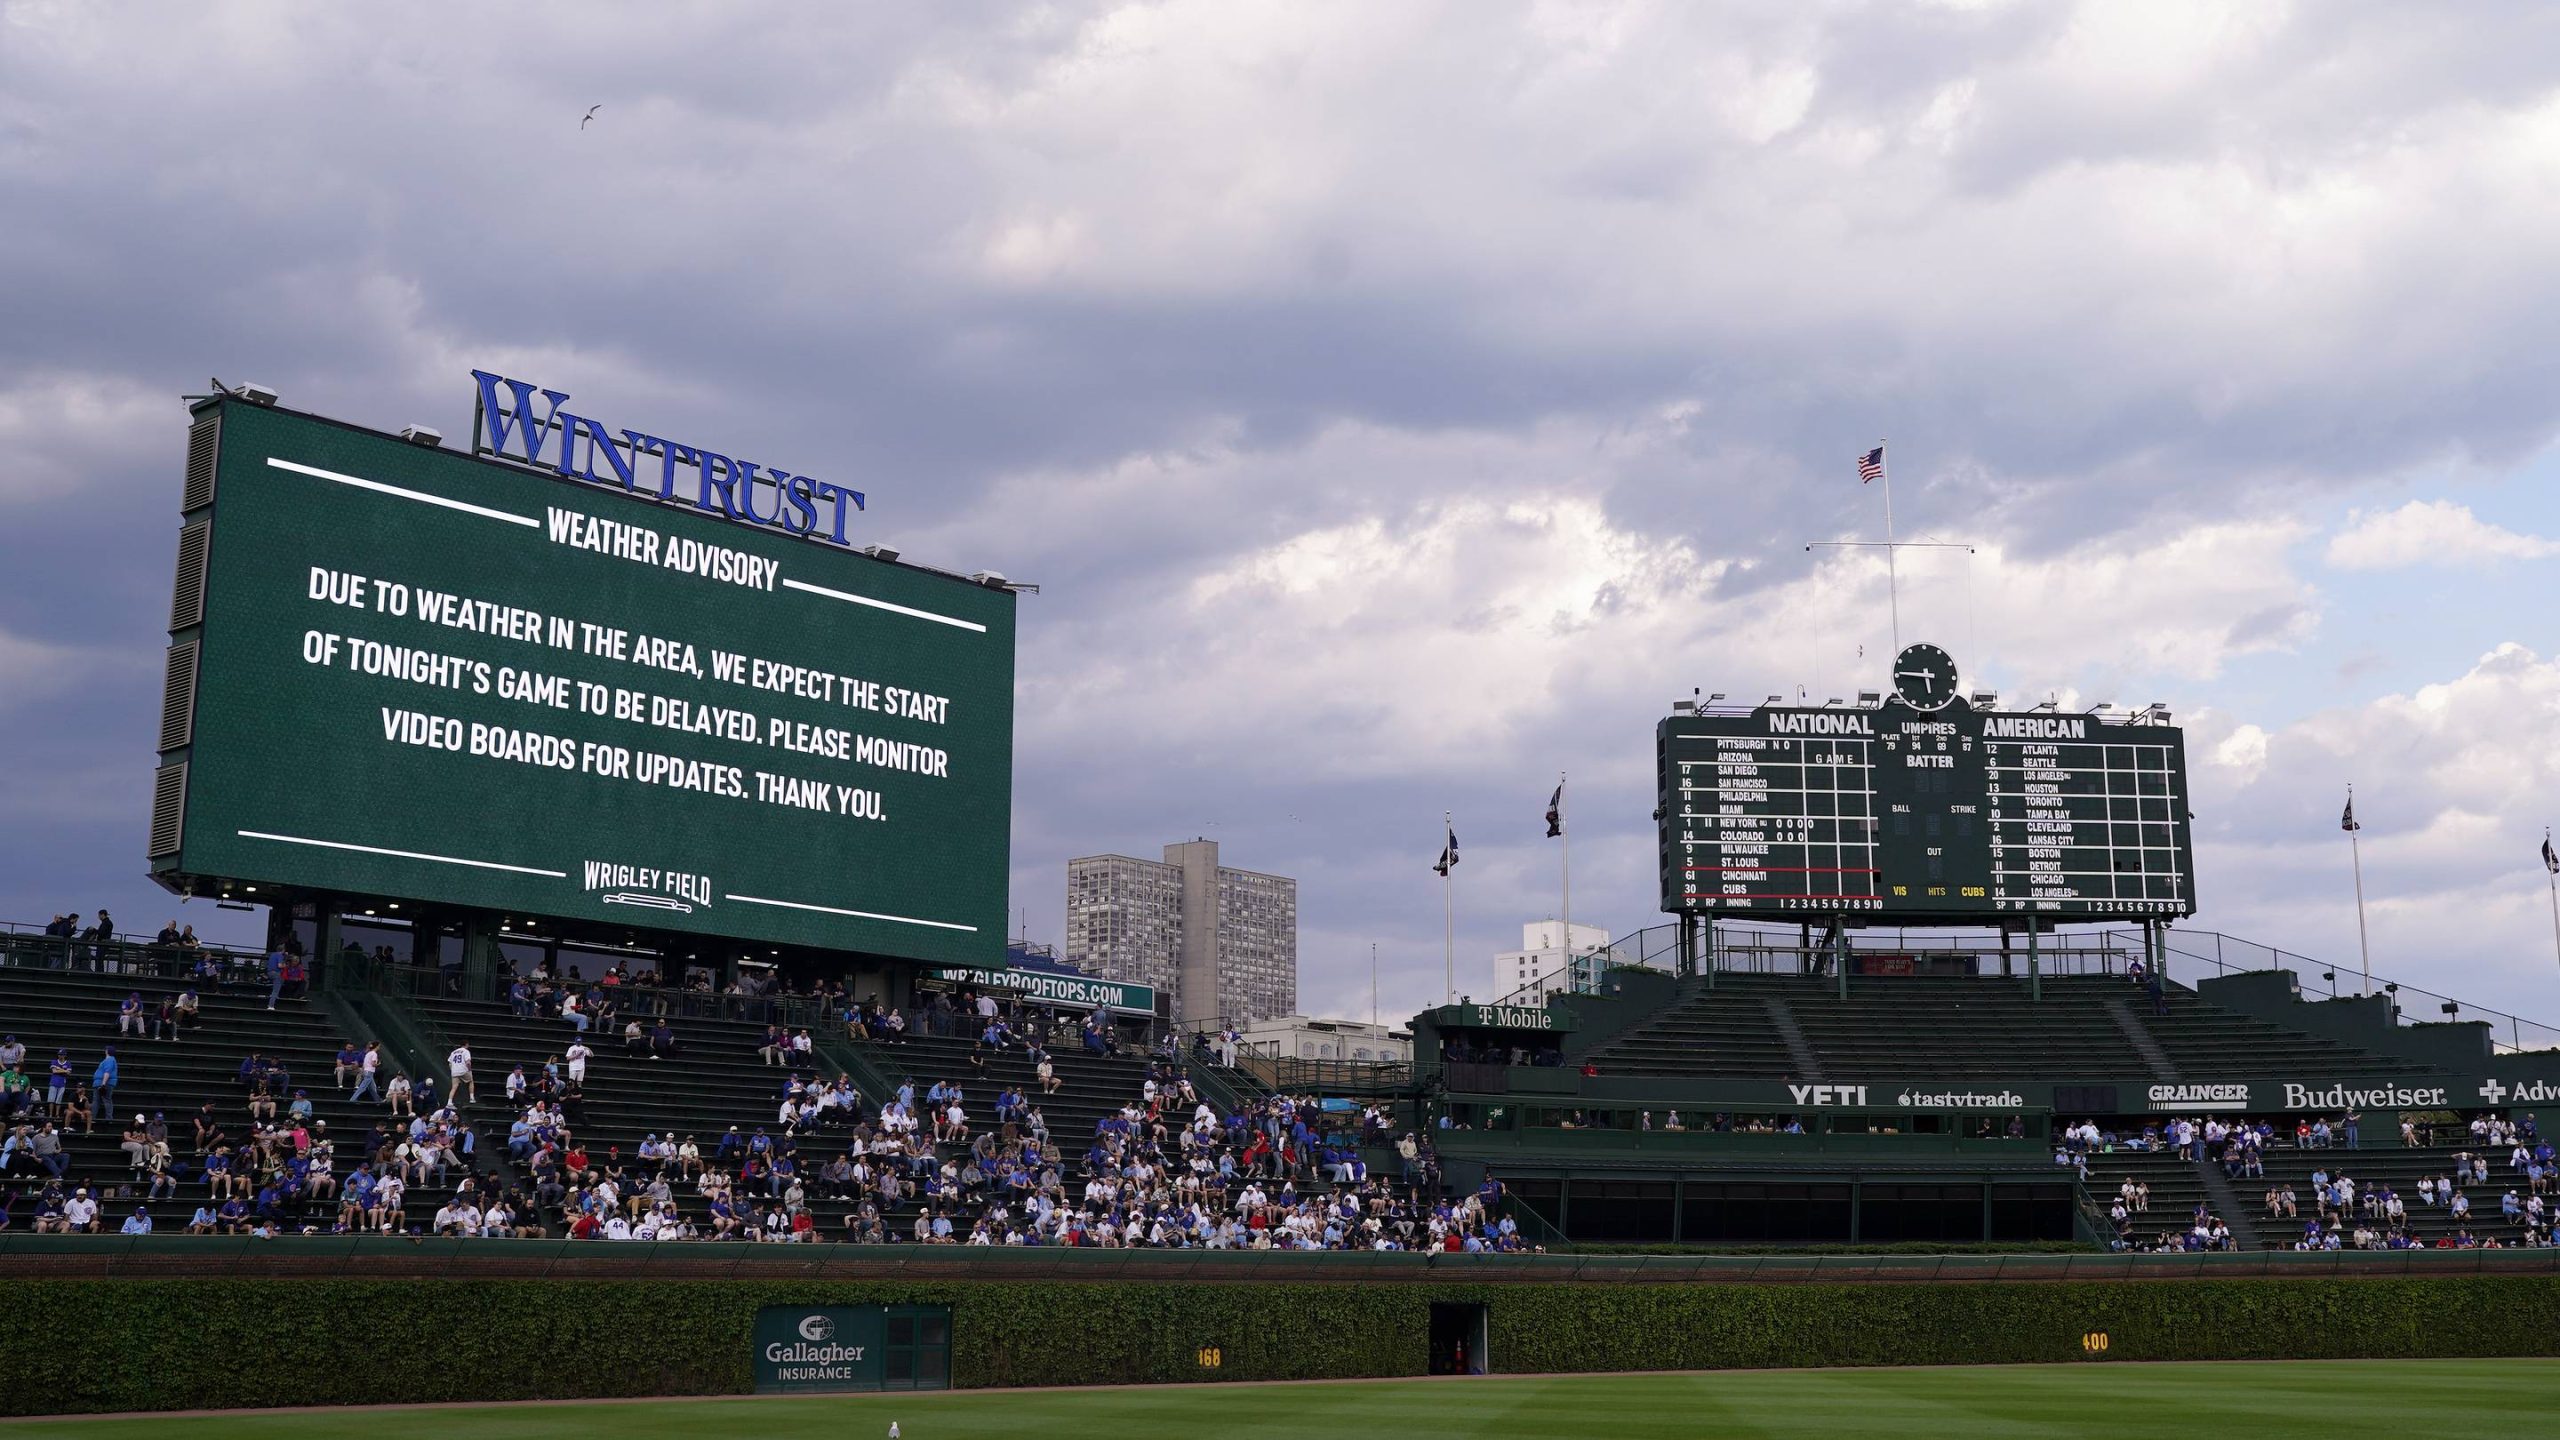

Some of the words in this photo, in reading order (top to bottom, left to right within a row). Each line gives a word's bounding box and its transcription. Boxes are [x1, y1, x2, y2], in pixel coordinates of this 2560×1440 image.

[472, 369, 865, 546] WINTRUST
[548, 506, 659, 566] WEATHER
[665, 535, 780, 592] ADVISORY
[309, 567, 366, 608] DUE
[374, 579, 408, 616] TO
[417, 588, 542, 644] WEATHER
[549, 616, 574, 650] IN
[580, 622, 627, 660] THE
[633, 635, 703, 679] AREA,
[711, 650, 746, 684] WE
[752, 658, 835, 701] EXPECT
[840, 677, 879, 711] THE
[885, 687, 949, 724] START
[303, 630, 340, 665] OF
[348, 638, 491, 694] TONIGHT'S
[498, 667, 571, 709] GAME
[577, 681, 608, 715] TO
[615, 688, 646, 722] BE
[652, 696, 762, 744] DELAYED.
[770, 718, 850, 760] PLEASE
[856, 734, 947, 778] MONITOR
[1769, 714, 1874, 734] NATIONAL
[1901, 722, 1956, 734] UMPIRES
[1983, 718, 2085, 738] AMERICAN
[1717, 740, 1766, 749] PITTSBURGH
[1987, 745, 1997, 754] 12
[2022, 746, 2058, 755] ATLANTA
[1718, 753, 1753, 762] ARIZONA
[1907, 755, 1954, 767] BATTER
[1990, 758, 1996, 766] 6
[2023, 758, 2056, 767] SEATTLE
[382, 707, 463, 751] VIDEO
[470, 722, 576, 770] BOARDS
[582, 742, 629, 779] FOR
[636, 751, 748, 798] UPDATES.
[756, 772, 831, 812] THANK
[837, 785, 886, 821] YOU.
[1682, 765, 1691, 774] 17
[1718, 766, 1733, 775] SAN
[1735, 766, 1757, 775] DIEGO
[1989, 771, 1998, 780] 20
[2024, 771, 2035, 780] LOS
[2037, 771, 2064, 780] ANGELES
[1682, 778, 1692, 787] 16
[1719, 778, 1731, 788] SAN
[1733, 779, 1767, 788] FRANCISCO
[1989, 784, 1999, 792] 13
[2025, 784, 2058, 793] HOUSTON
[1719, 792, 1767, 801] PHILADELPHIA
[1992, 797, 1998, 805] 9
[2026, 797, 2062, 806] TORONTO
[1685, 804, 1691, 813] 6
[1720, 805, 1743, 814] MIAMI
[1951, 805, 1976, 813] STRIKE
[1991, 809, 2000, 818] 10
[2026, 810, 2053, 819] TAMPA
[2055, 810, 2070, 819] BAY
[1686, 818, 1691, 826] 1
[1720, 818, 1736, 827] NEW
[1738, 818, 1757, 828] YORK
[1776, 819, 1782, 828] 0
[1787, 819, 1792, 828] 0
[1994, 823, 1999, 832] 2
[2027, 823, 2071, 832] CLEVELAND
[1684, 831, 1693, 840] 14
[1721, 832, 1764, 841] COLORADO
[1777, 832, 1783, 841] 0
[1788, 833, 1793, 841] 0
[1798, 833, 1804, 841] 0
[1992, 836, 2002, 844] 16
[2028, 836, 2056, 844] KANSAS
[2058, 836, 2074, 845] CITY
[1686, 845, 1692, 853] 9
[1721, 845, 1768, 854] MILWAUKEE
[1993, 848, 2002, 857] 15
[2029, 849, 2060, 858] BOSTON
[1686, 857, 1693, 866] 5
[1722, 858, 1733, 867] ST.
[1736, 858, 1758, 867] LOUIS
[2030, 862, 2061, 870] DETROIT
[585, 860, 660, 891] WRIGLEY
[1686, 871, 1695, 880] 61
[1722, 871, 1767, 880] CINCINNATI
[2030, 875, 2064, 884] CHICAGO
[1685, 884, 1696, 894] 30
[1723, 885, 1746, 894] CUBS
[1893, 886, 1907, 895] VIS
[1962, 887, 1985, 896] CUBS
[1995, 888, 2005, 897] 14
[2031, 888, 2043, 897] LOS
[2044, 888, 2071, 897] ANGELES
[1780, 899, 1784, 908] 1
[1790, 899, 1796, 908] 2
[1802, 899, 1808, 908] 3
[1811, 899, 1817, 908] 4
[1822, 899, 1828, 908] 5
[1832, 900, 1838, 908] 6
[1843, 900, 1849, 908] 7
[1854, 900, 1860, 909] 8
[1864, 900, 1870, 909] 9
[1874, 900, 1883, 909] 10
[2088, 902, 2091, 911] 1
[2097, 902, 2103, 911] 2
[2107, 903, 2113, 911] 3
[2117, 903, 2123, 911] 4
[2128, 903, 2133, 911] 5
[2137, 903, 2143, 911] 6
[2148, 903, 2153, 911] 7
[2158, 903, 2164, 912] 8
[2168, 903, 2174, 912] 9
[2177, 903, 2186, 912] 10
[943, 969, 1122, 1005] WRGLEYROOFTOPS.COM
[1479, 1006, 1492, 1025] T
[1497, 1007, 1551, 1029] Mobile
[1788, 1085, 1866, 1106] YETI
[2149, 1085, 2248, 1101] GRAINGER
[2283, 1083, 2444, 1108] Budweiser
[1913, 1091, 2023, 1107] tastytrade
[2082, 1333, 2108, 1350] 400
[766, 1343, 864, 1366] Gallagher
[778, 1367, 851, 1380] INSURANCE
